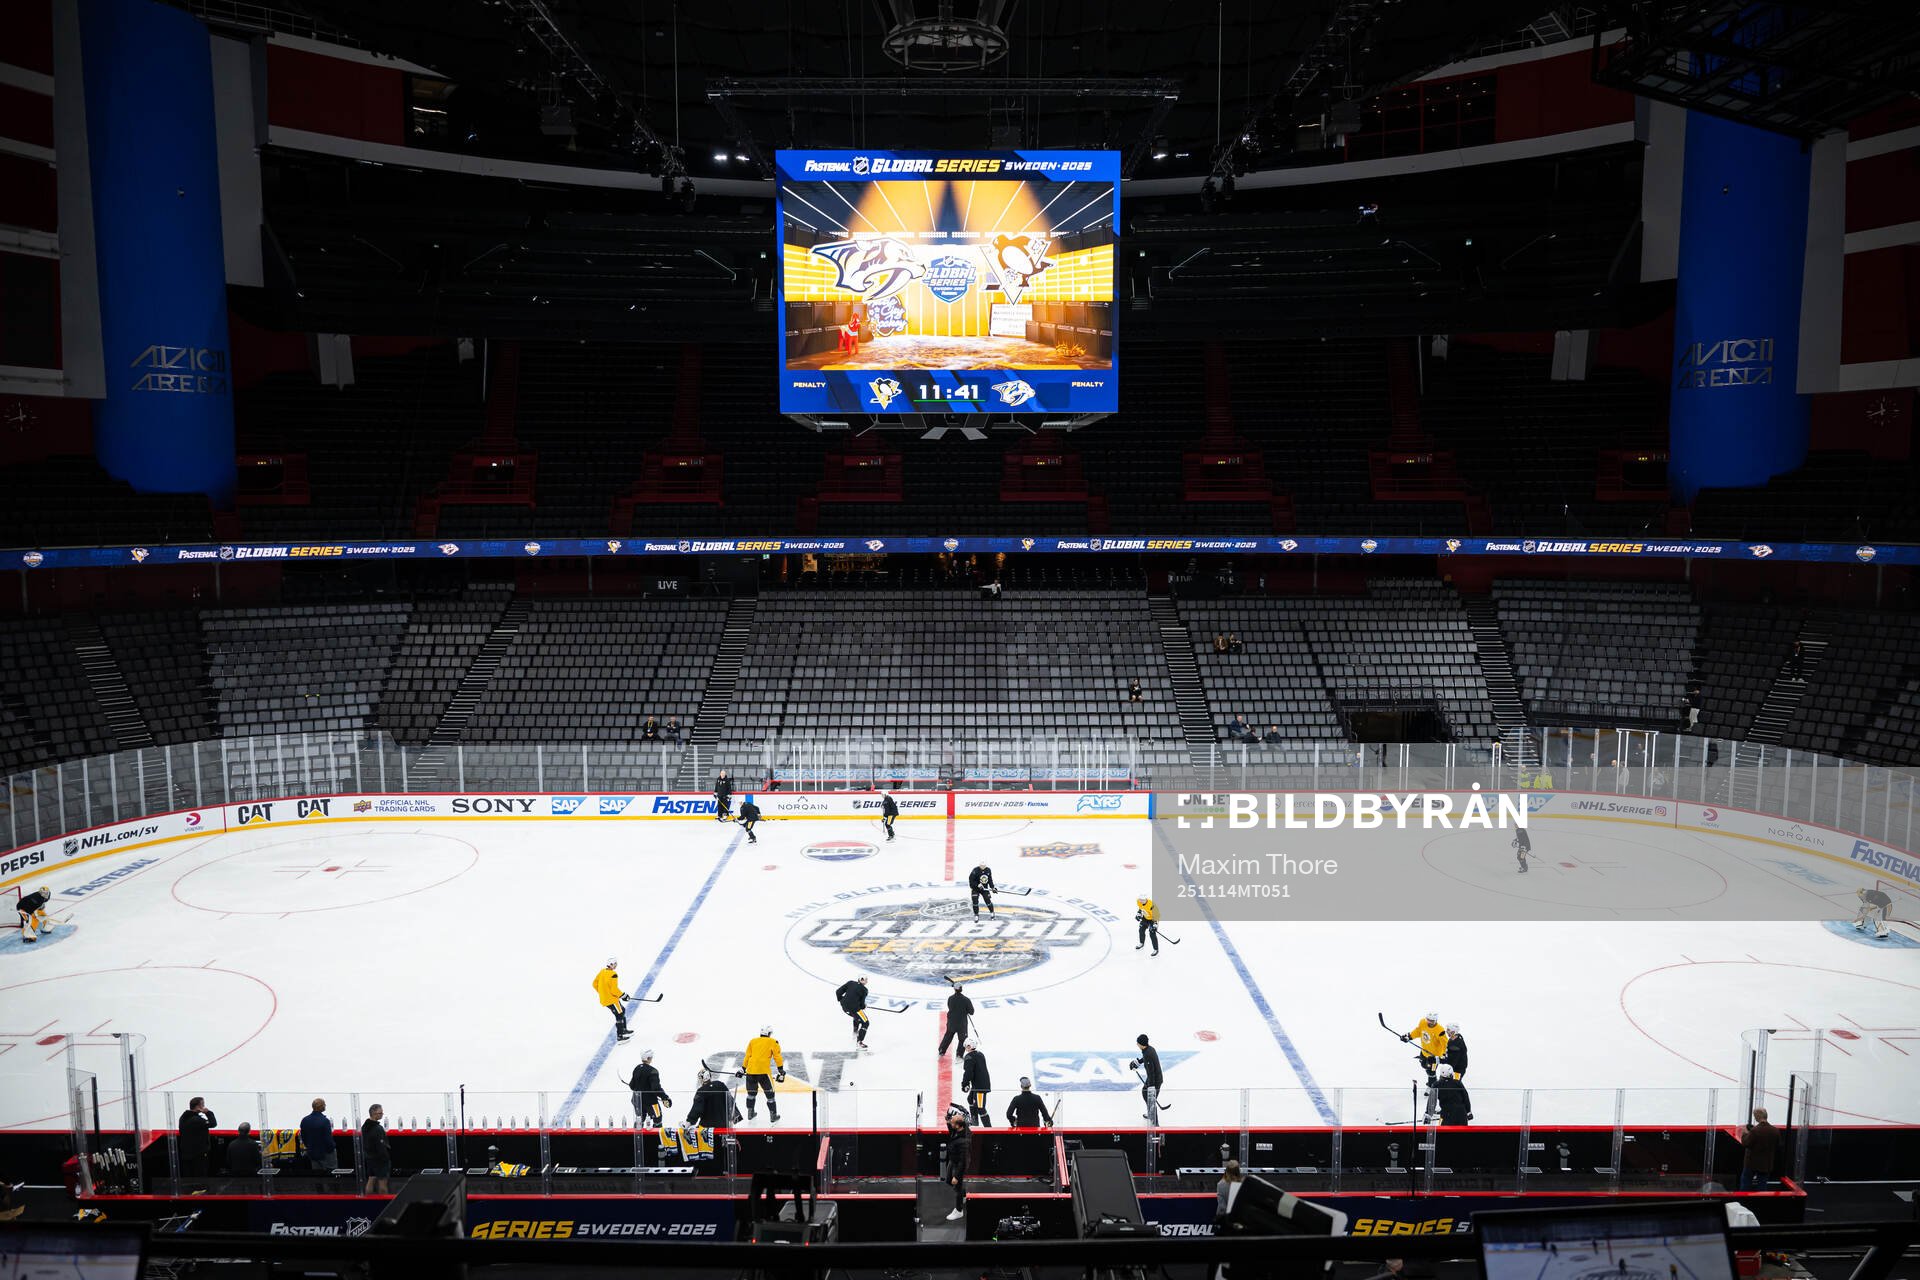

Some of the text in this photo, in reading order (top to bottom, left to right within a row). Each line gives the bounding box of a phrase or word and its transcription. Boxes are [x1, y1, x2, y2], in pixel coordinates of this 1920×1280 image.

[805, 160, 850, 172] FASTENAL
[871, 158, 934, 173] GLOBAL
[934, 159, 1001, 173] SERIES
[919, 384, 980, 400] 11:41
[645, 543, 678, 551] FASTENAL
[691, 541, 735, 552] GLOBAL
[736, 541, 782, 551] SERIES
[1057, 541, 1089, 549] FASTENAL
[1102, 540, 1146, 549] GLOBAL
[1147, 540, 1193, 550] SERIES
[1486, 542, 1521, 551] FASTENAL
[1537, 541, 1587, 552] GLOBAL
[1588, 543, 1643, 553] SERIES
[178, 550, 218, 559] FASTENAL
[236, 547, 288, 558] GLOBAL
[289, 546, 344, 557] SERIES
[297, 799, 331, 819] CAT
[452, 798, 537, 813] SONY
[552, 799, 580, 812] SAP
[600, 799, 627, 812] SAP
[778, 803, 828, 811] NORQAIN
[899, 800, 937, 808] SERIES
[238, 803, 273, 825] CAT
[1767, 826, 1825, 847] NORQAIN
[1, 850, 45, 876] PEPSI
[804, 919, 1086, 942] GLOBAL
[842, 939, 1039, 953] SERIES
[271, 1222, 340, 1236] FASTENAL
[471, 1220, 574, 1240] SERIES
